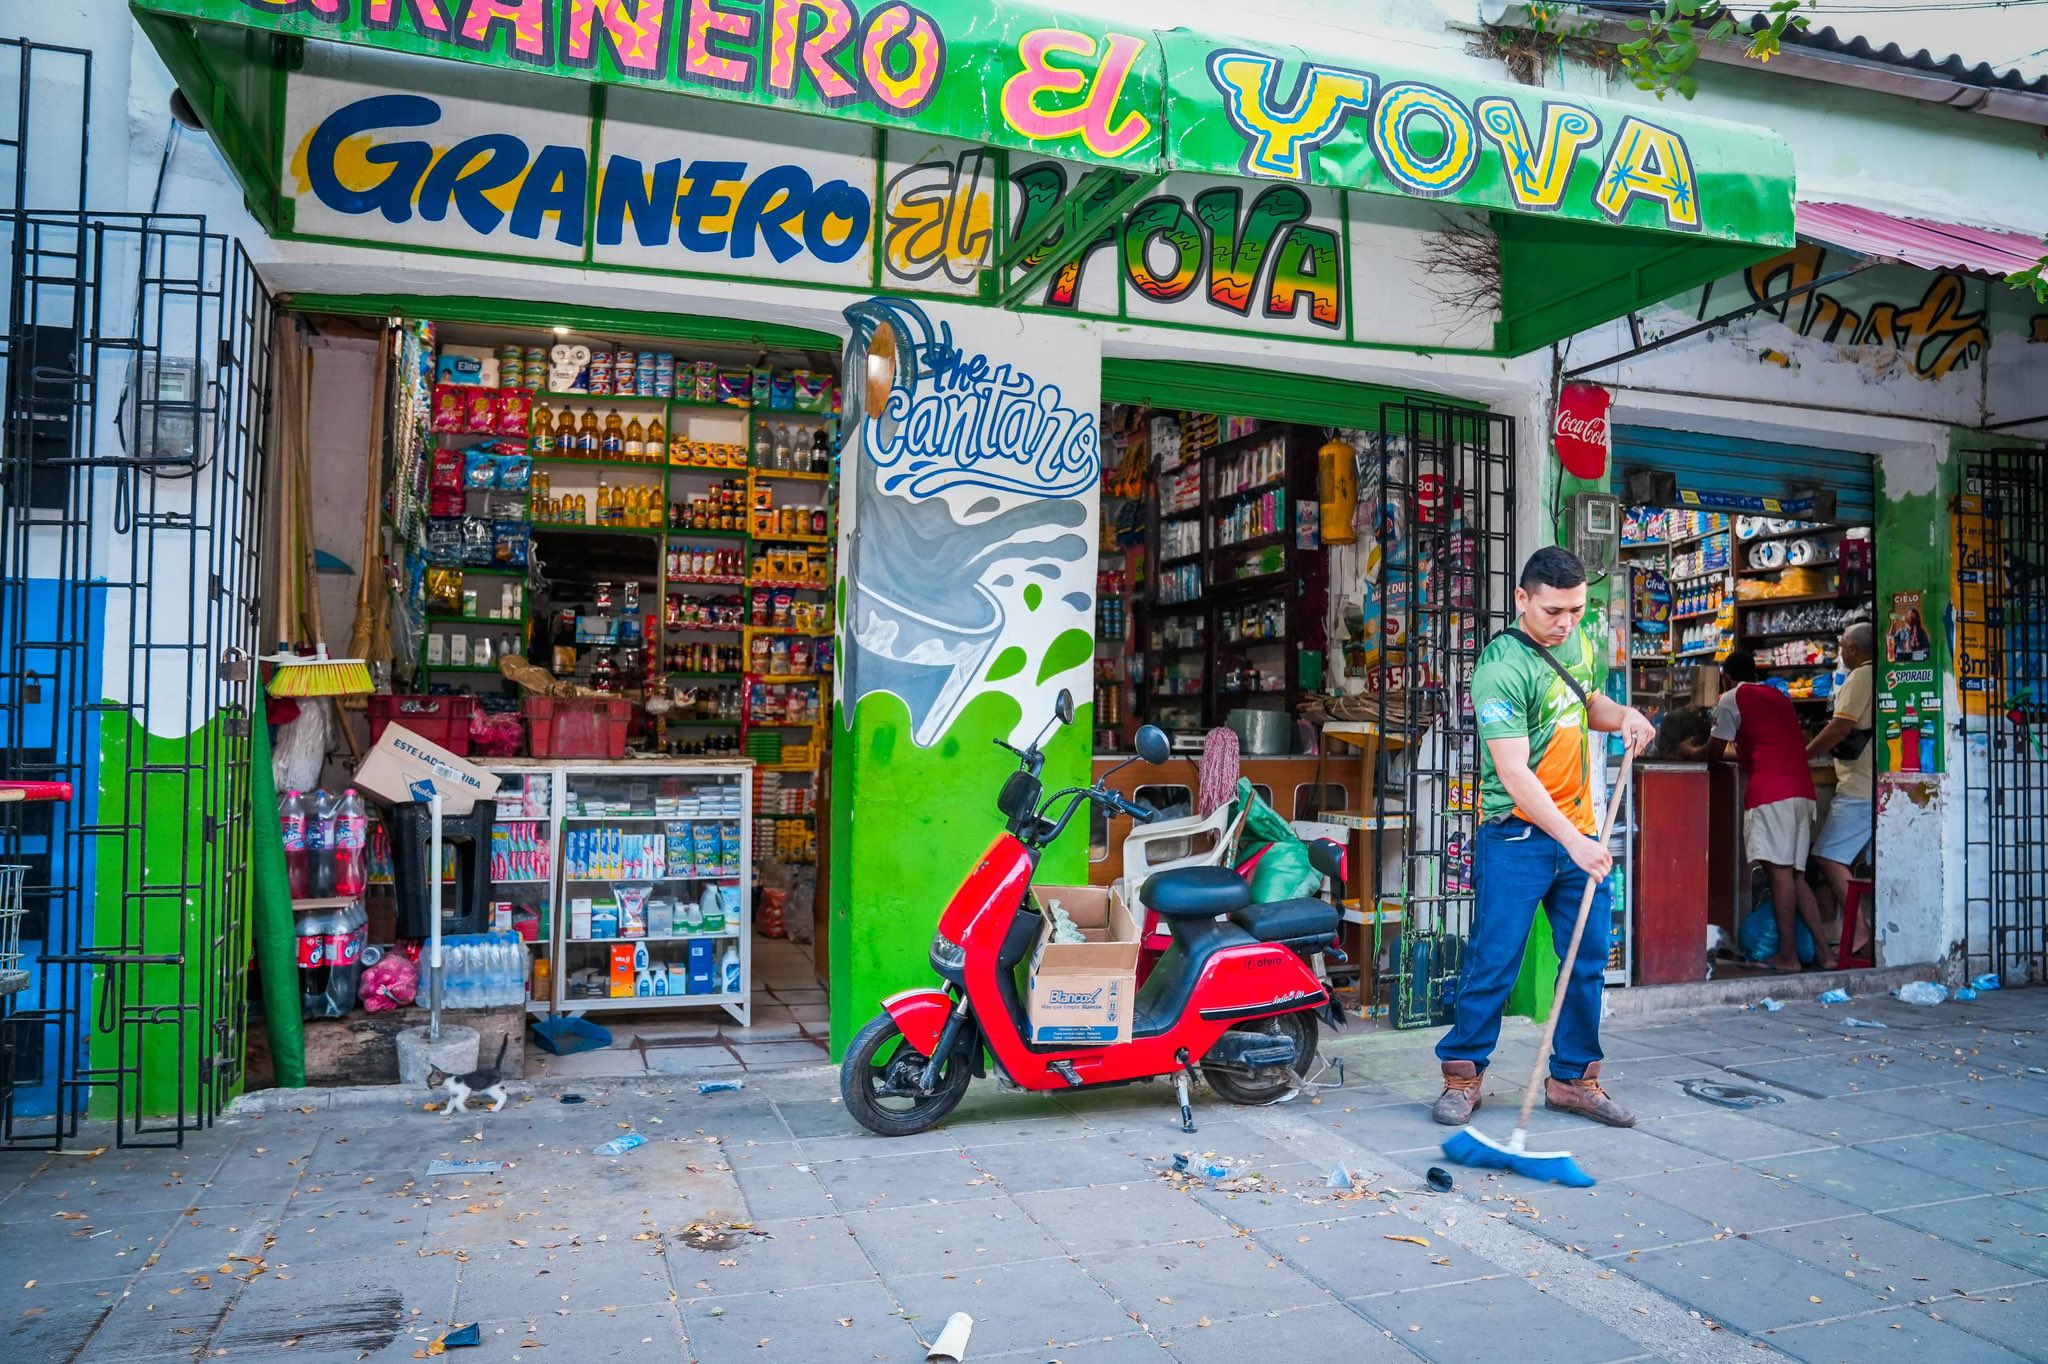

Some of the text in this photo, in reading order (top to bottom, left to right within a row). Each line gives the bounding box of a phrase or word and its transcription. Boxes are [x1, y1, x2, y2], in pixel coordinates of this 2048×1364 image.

[238, 0, 1702, 232] ANERO El YOVA
[306, 94, 1343, 331] GRANERO El YOVA
[457, 361, 481, 372] Elite
[1555, 409, 1607, 447] Coca-Cola
[1417, 479, 1443, 494] Bay
[1894, 595, 1919, 603] CIELO
[1895, 669, 1933, 682] SPORADE
[393, 738, 419, 756] ESTE
[449, 765, 481, 789] RIBA
[1257, 957, 1282, 968] ofero
[1049, 987, 1102, 1004] Blancox
